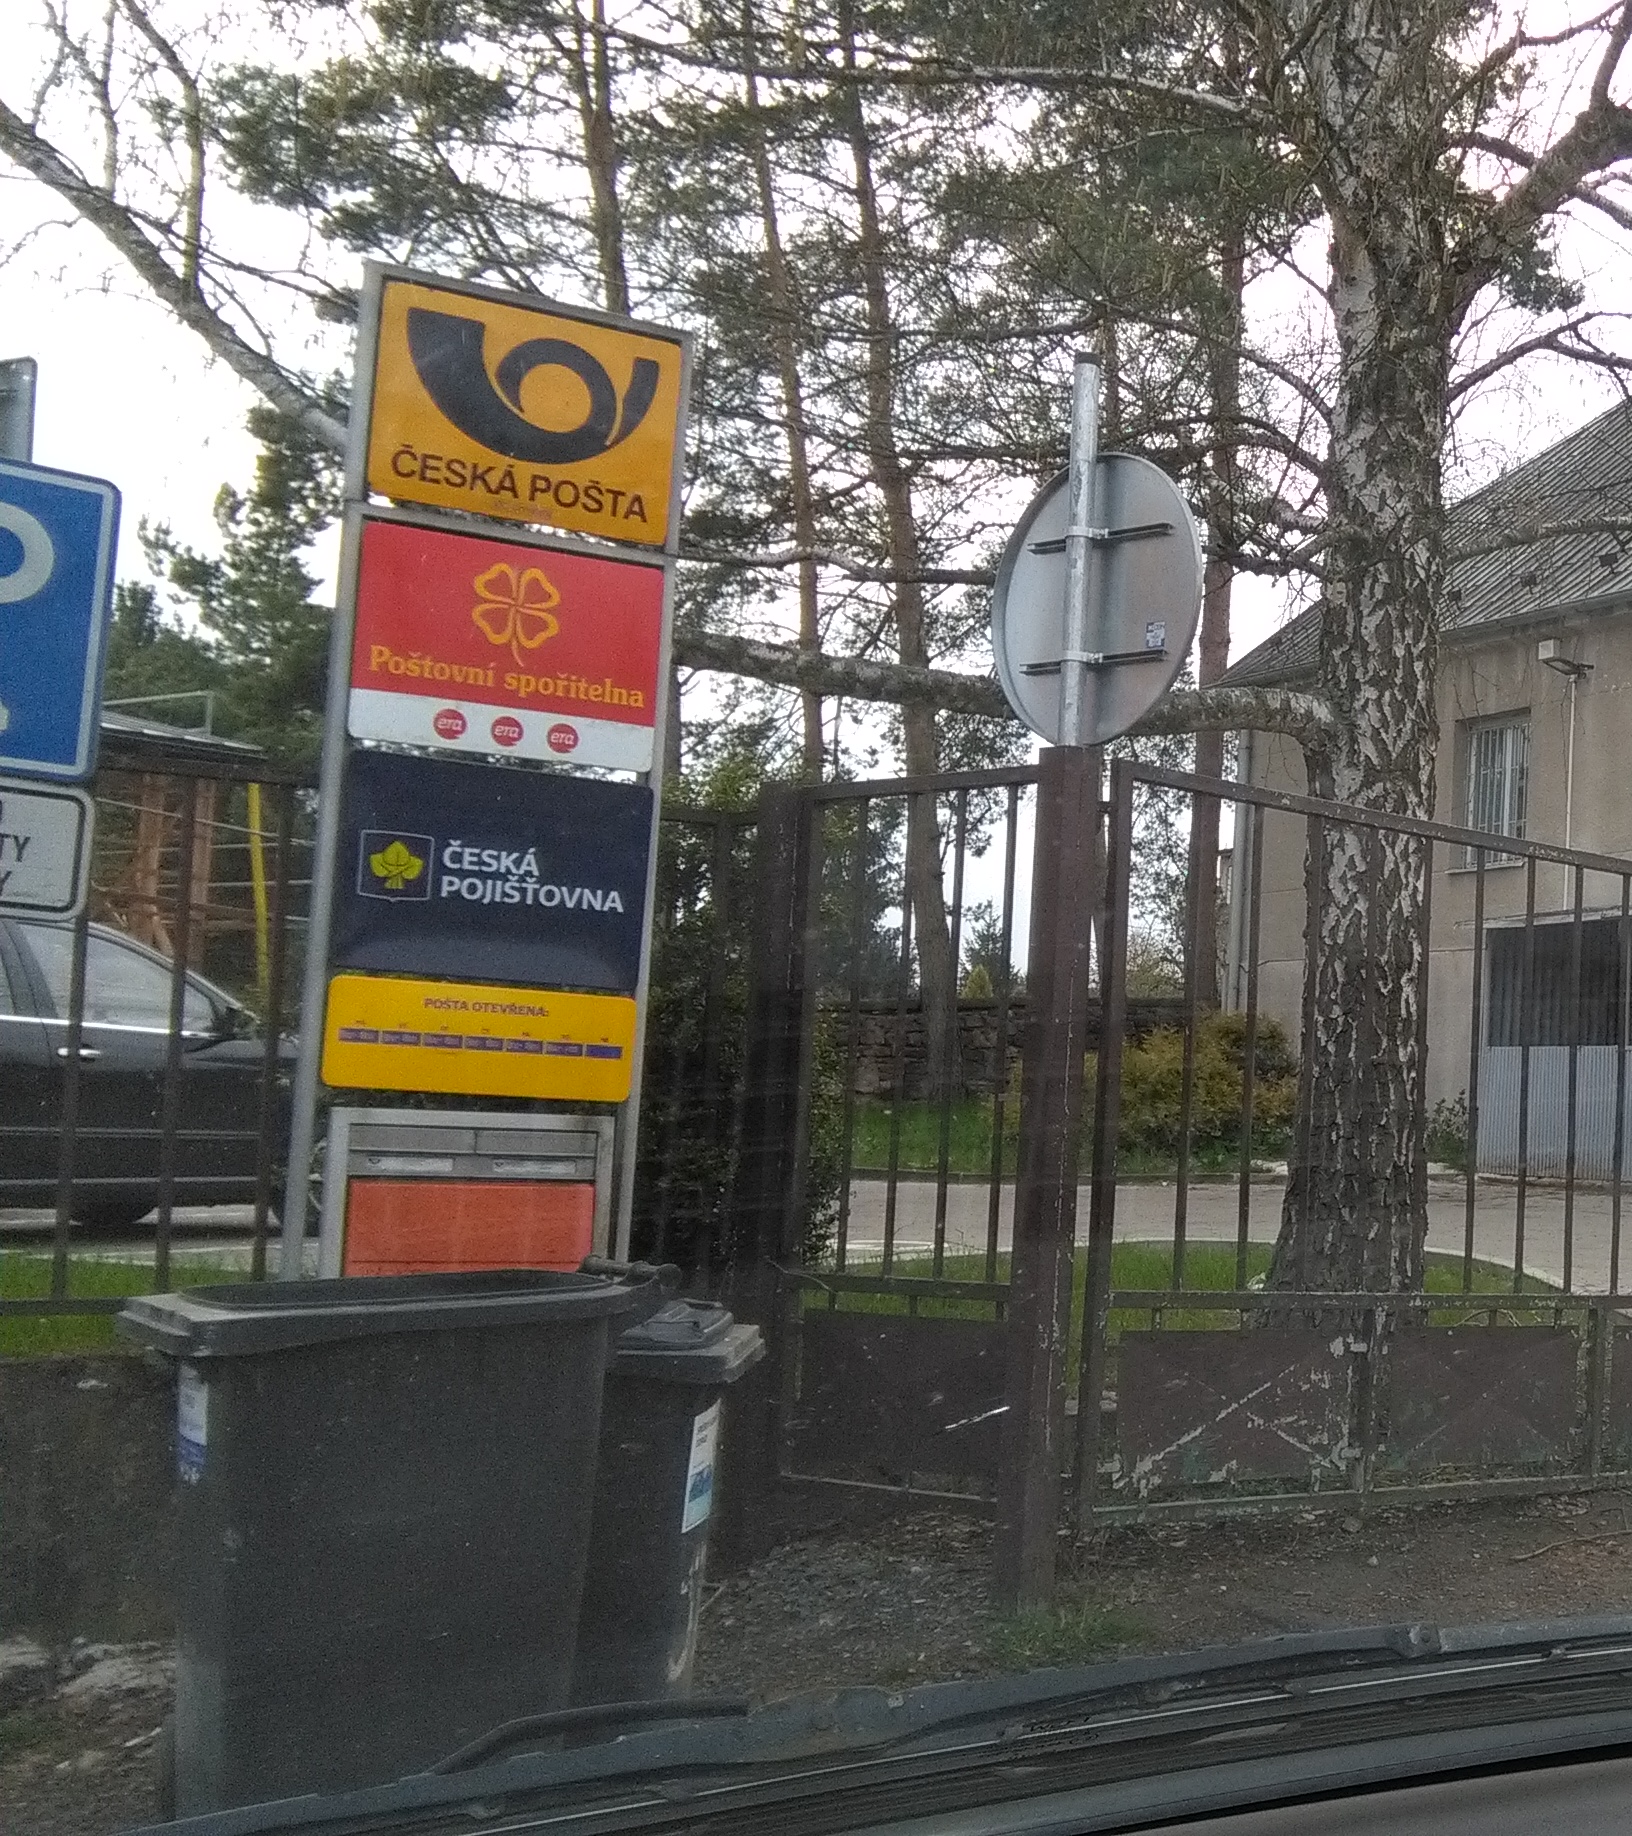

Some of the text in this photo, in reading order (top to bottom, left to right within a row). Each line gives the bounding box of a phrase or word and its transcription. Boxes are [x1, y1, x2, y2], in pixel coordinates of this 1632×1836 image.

[391, 443, 520, 500] ČESKÁ
[528, 473, 648, 524] POŠTA
[369, 645, 645, 709] Poštovní spořitelna
[436, 714, 463, 732] era
[493, 722, 520, 739] era
[550, 730, 575, 746] era
[442, 839, 540, 877] ČESKÁ
[440, 874, 624, 914] POJIŠŤOVNA
